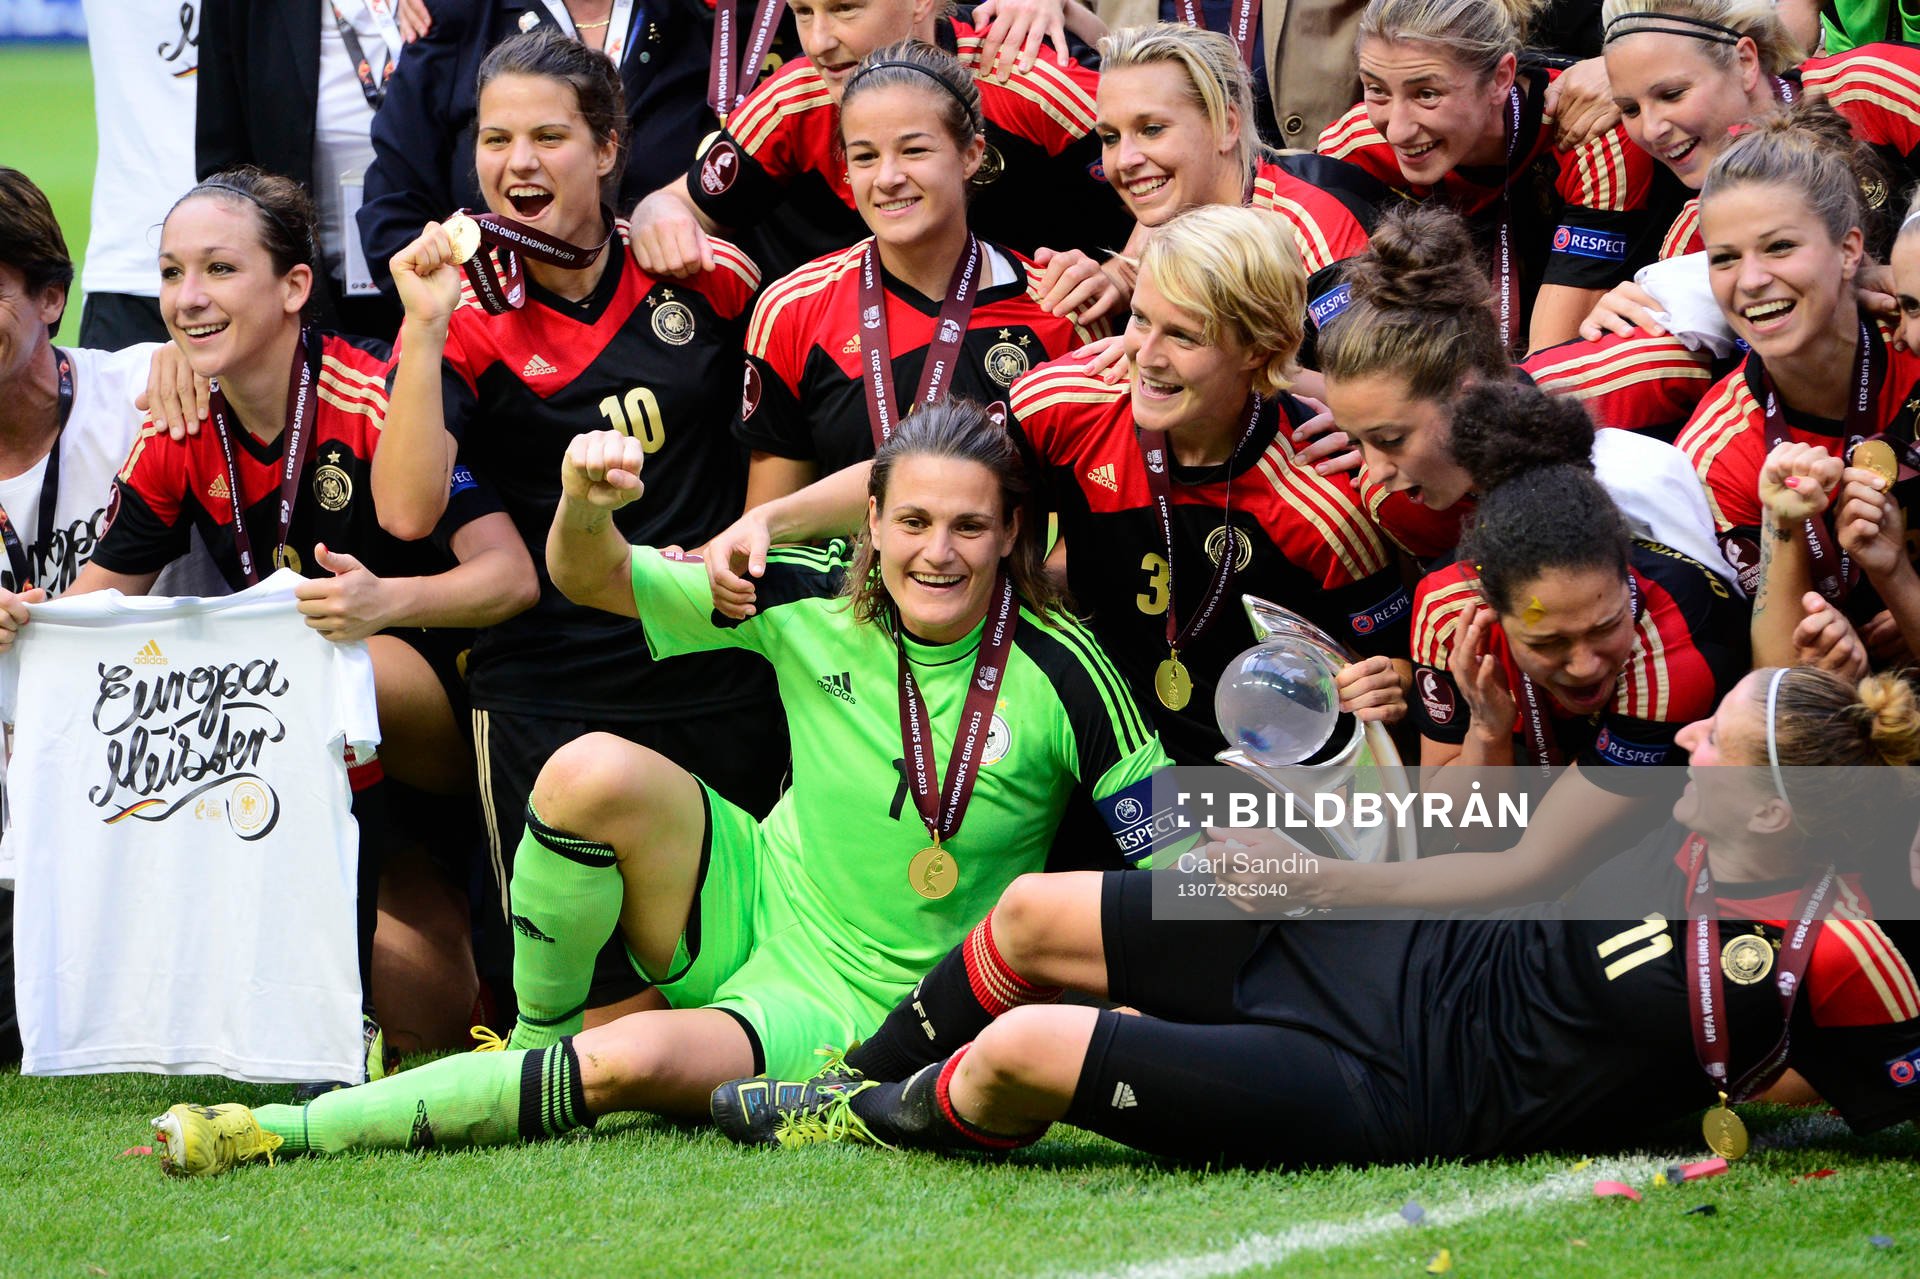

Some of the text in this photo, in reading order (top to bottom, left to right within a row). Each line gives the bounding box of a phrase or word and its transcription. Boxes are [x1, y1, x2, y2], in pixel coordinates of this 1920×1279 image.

[479, 218, 499, 233] 2013
[499, 226, 521, 242] EURO
[1570, 234, 1627, 254] RESPECT
[964, 255, 978, 282] EURO
[1501, 248, 1509, 274] EURO
[956, 280, 970, 302] 2013
[523, 366, 558, 377] adidas
[871, 348, 882, 373] 2013
[931, 360, 944, 388] UEFA
[1861, 358, 1870, 386] EURO
[873, 372, 885, 400] EURO
[1858, 387, 1869, 412] 2013
[599, 387, 665, 454] 10
[289, 431, 300, 456] EURO
[1087, 472, 1118, 493] adidas
[1136, 552, 1170, 616] 3
[1203, 596, 1219, 618] EURO
[993, 620, 1007, 647] UEFA
[134, 656, 168, 665] adidas
[93, 658, 289, 739] Europa
[816, 679, 857, 705] adidas
[904, 672, 928, 796] UEFA WOMEN'S EURO 2013
[1608, 742, 1667, 764] RESPECT
[943, 710, 983, 832] UEFA WOMEN'S EURO 2013
[1115, 812, 1177, 851] RESPECT
[1596, 911, 1674, 982] 11
[1697, 938, 1710, 966] EURO
[1698, 966, 1713, 1014] WOMEN'S
[1703, 1014, 1717, 1043] UEFA
